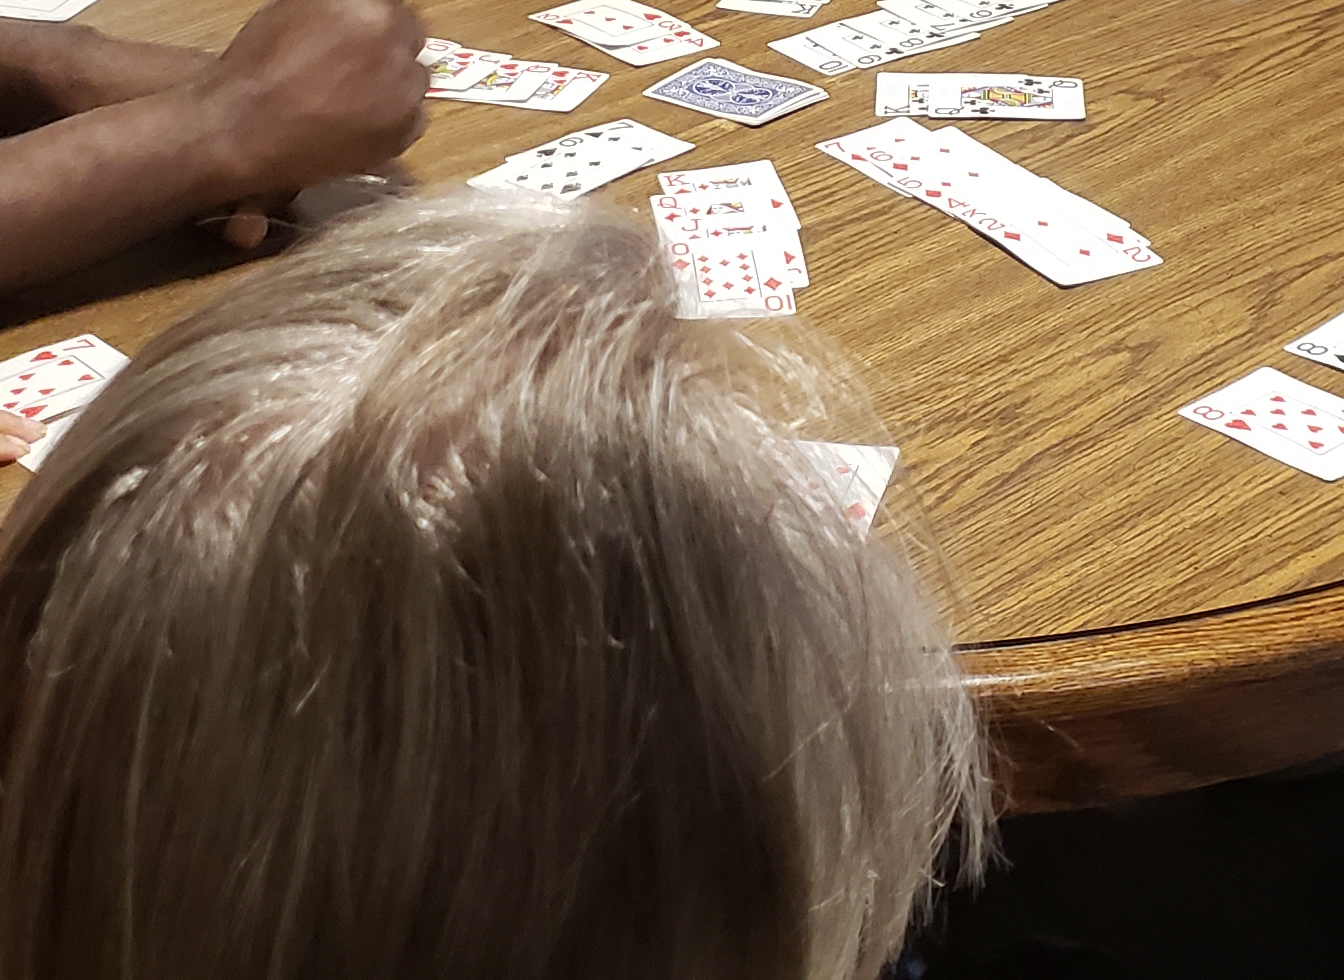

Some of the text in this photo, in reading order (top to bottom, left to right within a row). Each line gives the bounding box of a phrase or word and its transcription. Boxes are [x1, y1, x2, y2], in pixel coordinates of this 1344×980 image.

[792, 3, 817, 14] K
[930, 22, 955, 31] 7
[426, 40, 457, 52] 10
[684, 38, 704, 48] 4
[899, 37, 924, 47] 8
[478, 54, 501, 64] J
[525, 65, 551, 73] Q
[819, 59, 848, 74] 10
[574, 71, 602, 82] K
[1048, 80, 1078, 89] Q
[884, 104, 910, 115] K
[934, 106, 965, 115] Q
[608, 121, 635, 130] 7
[824, 141, 846, 152] 7
[664, 174, 691, 186] K
[896, 176, 923, 189] 5
[657, 196, 682, 209] Q
[947, 197, 970, 209] 4
[681, 218, 701, 231] J
[978, 218, 1006, 231] 2
[1122, 246, 1152, 262] 2
[764, 294, 793, 312] 10
[62, 339, 96, 351] 7
[1296, 341, 1329, 356] 8
[1192, 404, 1225, 421] 8
